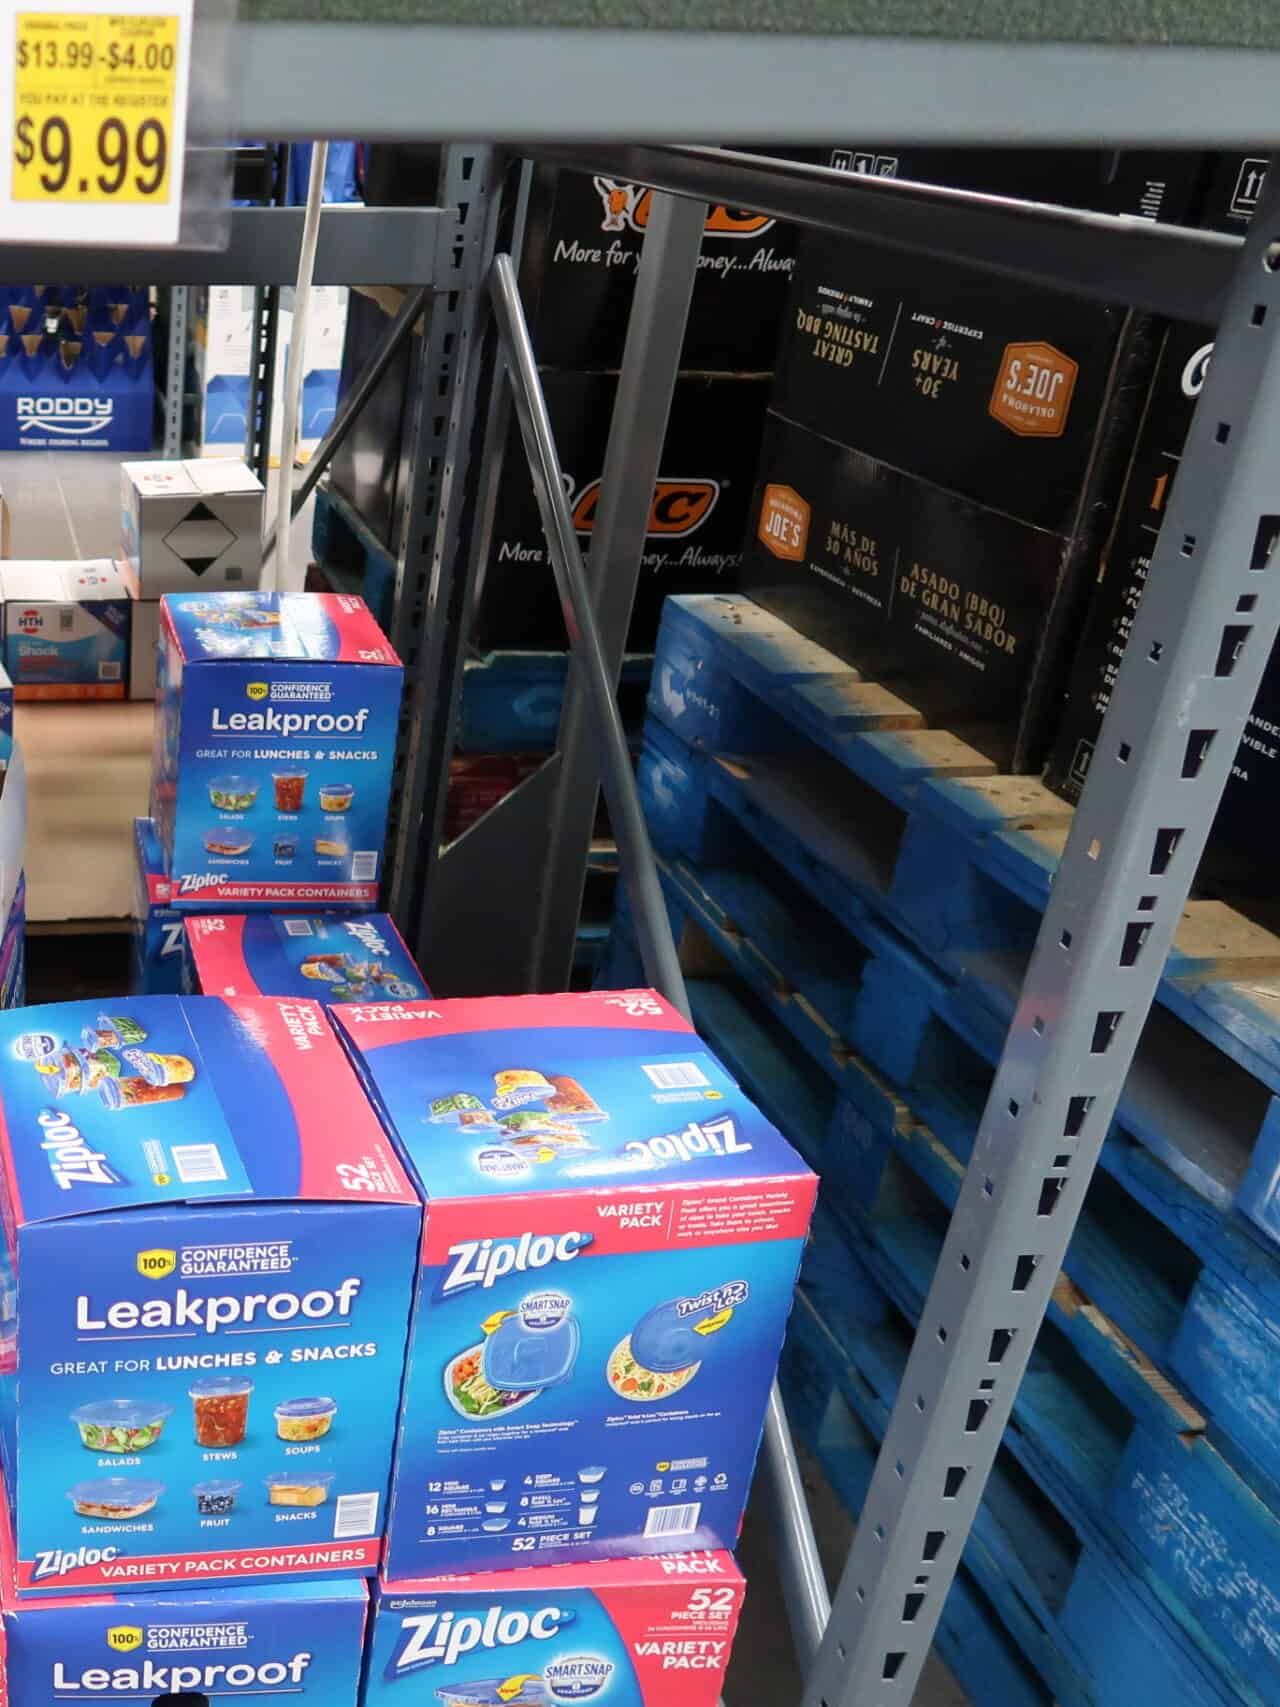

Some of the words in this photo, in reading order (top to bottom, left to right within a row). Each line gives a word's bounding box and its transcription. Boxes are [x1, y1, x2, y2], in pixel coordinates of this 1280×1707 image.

[15, 112, 167, 195] $9.99
[553, 240, 601, 264] More
[605, 240, 632, 267] for
[796, 308, 821, 335] BBQ
[825, 320, 880, 355] TASTING
[813, 338, 854, 368] GREAT
[911, 349, 960, 382] YEARS
[914, 375, 942, 399] 30+
[1006, 359, 1064, 402] JOE'S
[16, 398, 113, 415] RODDY
[765, 511, 801, 548] JOE'S
[498, 541, 543, 563] More
[910, 562, 961, 601] ASADO
[964, 591, 1007, 629] (BBQ)
[18, 615, 44, 627] HTH
[900, 575, 917, 600] DE
[921, 584, 962, 622] GRAN
[964, 611, 1017, 655] SABOR
[211, 708, 370, 736] Leakproof
[231, 750, 252, 759] FOR
[254, 750, 310, 760] LUNCHES
[329, 751, 378, 761] SNACKS
[180, 871, 229, 892] Ziploc
[217, 886, 263, 898] VARIETY
[265, 887, 297, 898] PACK
[298, 887, 370, 898] CONTAINERS
[300, 1002, 325, 1037] PACK
[349, 1003, 405, 1014] PACK
[353, 1008, 444, 1023] VARIETY
[624, 1000, 665, 1017] 52
[278, 1001, 312, 1051] VARIETY
[37, 1111, 114, 1191] Ziploc
[625, 1119, 754, 1164] Ziploc
[335, 1163, 375, 1192] 52
[596, 1200, 665, 1219] VARIETY
[619, 1214, 663, 1229] PACK
[181, 1244, 289, 1262] CONFIDENCE
[442, 1230, 581, 1290] Ziploc
[181, 1256, 292, 1275] GUARANTEED
[76, 1278, 362, 1334] Leakproof
[50, 1360, 108, 1376] GREAT
[114, 1359, 151, 1373] FOR
[156, 1351, 257, 1371] LUNCHES
[264, 1351, 284, 1365] &
[291, 1343, 378, 1363] SNACKS
[97, 1457, 141, 1468] SALADS
[202, 1451, 238, 1462] STEWS
[285, 1444, 321, 1456] SOUPS
[428, 1481, 442, 1493] 12
[524, 1475, 533, 1485] 4
[425, 1504, 439, 1515] 16
[80, 1522, 154, 1535] SANDWICHES
[199, 1518, 231, 1529] FRUIT
[275, 1511, 317, 1523] SNACKS
[511, 1536, 537, 1552] 52
[540, 1532, 571, 1544] PIECE
[573, 1531, 593, 1541] SET
[34, 1545, 119, 1579] Ziploc
[100, 1561, 182, 1578] VARIETY
[185, 1558, 239, 1574] PACK
[240, 1547, 366, 1569] CONTAINERS
[662, 1559, 725, 1576] PACK
[687, 1588, 736, 1612] 52
[671, 1610, 709, 1621] PIECE
[710, 1610, 733, 1620] SET
[148, 1625, 246, 1639] CONFIDENCE
[148, 1635, 248, 1649] GUARANTEED
[397, 1605, 562, 1668] Ziploc
[633, 1640, 727, 1657] VARIETY
[53, 1652, 312, 1693] Leakproof
[662, 1655, 724, 1670] PACK
